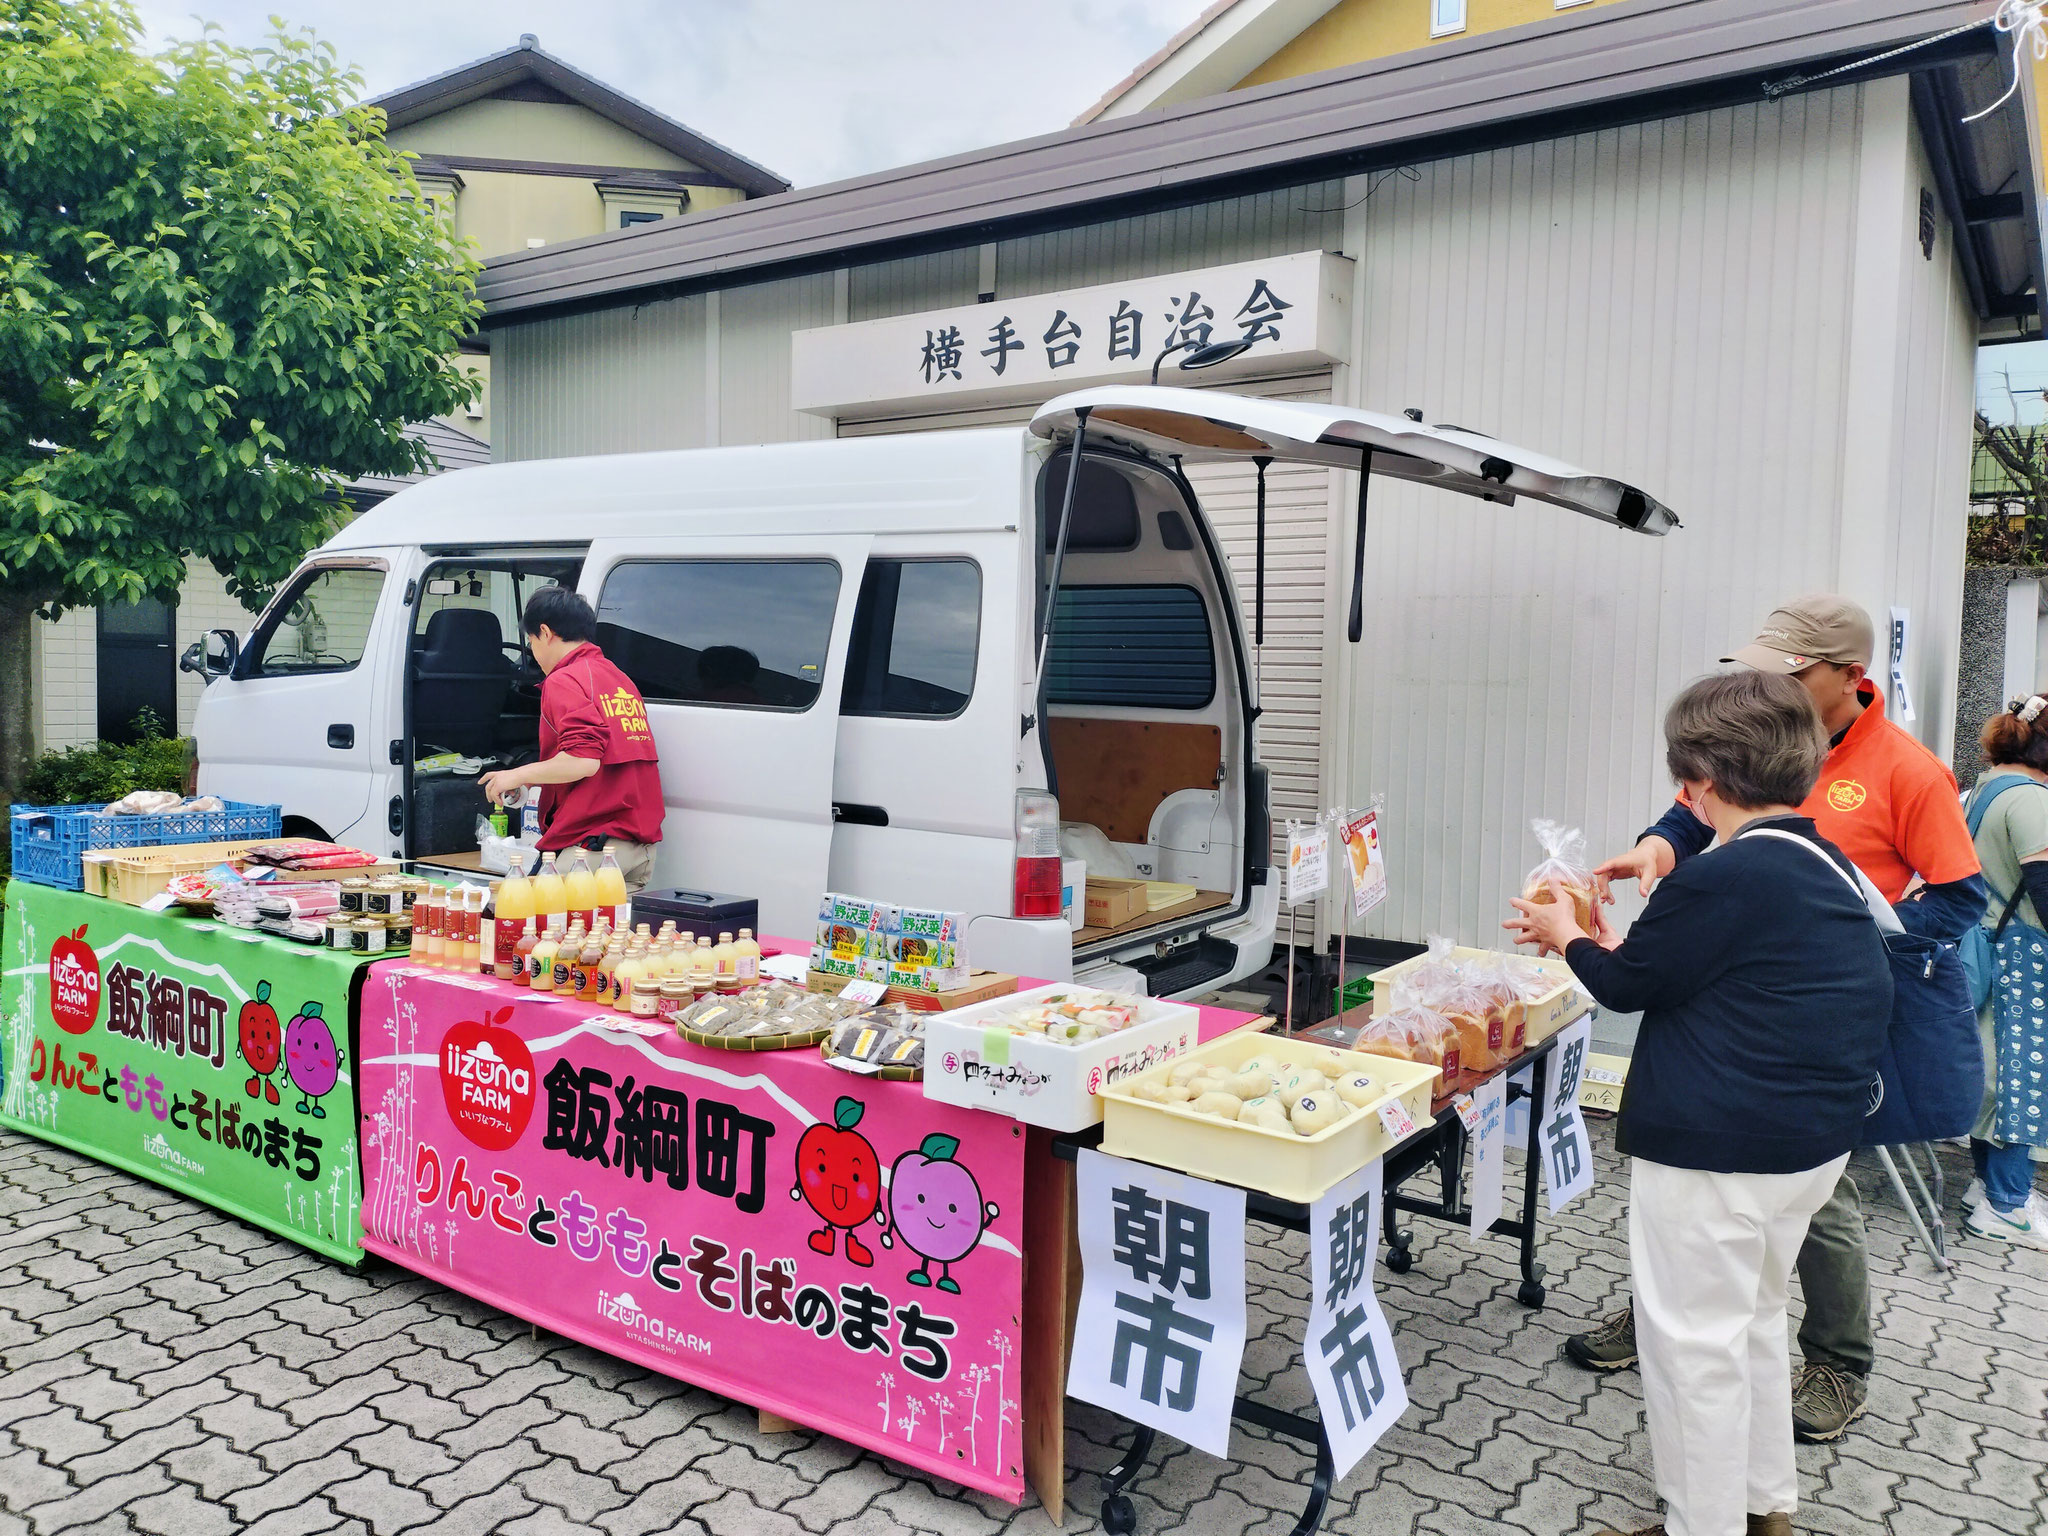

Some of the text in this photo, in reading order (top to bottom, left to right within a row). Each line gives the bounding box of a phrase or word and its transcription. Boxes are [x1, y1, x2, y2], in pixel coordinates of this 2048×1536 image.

[919, 279, 1294, 385] 横手台自治会
[834, 904, 871, 926] 野沢菜
[902, 916, 941, 935] 野沢菜
[53, 954, 98, 991] iizuna
[825, 958, 857, 977] 野沢菜
[890, 970, 922, 988] 野沢菜
[57, 985, 88, 1007] FARM
[106, 960, 228, 1069] 飯綱町
[447, 1041, 530, 1096] iizuna
[30, 1035, 323, 1181] りんごとももとそばのまち
[459, 1109, 513, 1133] いいづなファーム
[462, 1082, 511, 1114] FARM
[1546, 1035, 1585, 1189] 朝市
[143, 1133, 205, 1176] iizuna FARM
[543, 1057, 776, 1214] 飯綱町
[415, 1141, 958, 1382] りんごとももとそばのまち
[597, 1289, 712, 1356] iizuna FARM
[1109, 1184, 1216, 1414] 朝市
[1320, 1190, 1387, 1434] 朝市
[626, 1331, 677, 1356] KITASHINSHU
